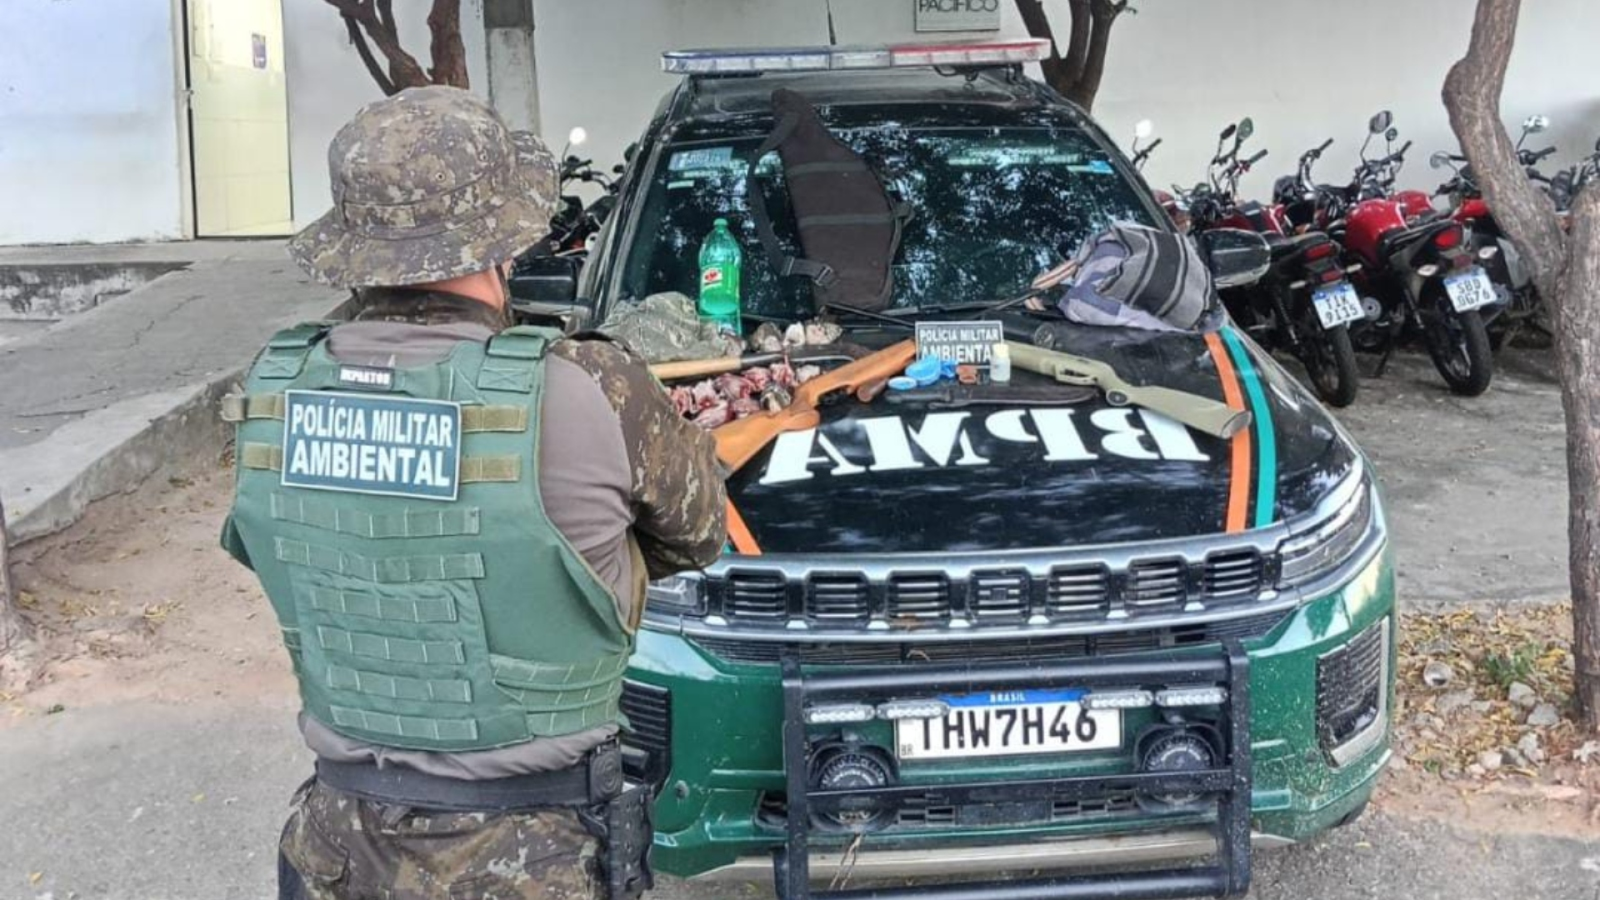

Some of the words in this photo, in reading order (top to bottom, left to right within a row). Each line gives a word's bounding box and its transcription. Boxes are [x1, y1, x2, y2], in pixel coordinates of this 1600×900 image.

[960, 328, 999, 341] MILITAR
[921, 343, 992, 362] AMBIENTA
[291, 398, 366, 440] POLÍCIA
[371, 409, 453, 447] MILITAR
[289, 439, 450, 487] AMBIENTAL
